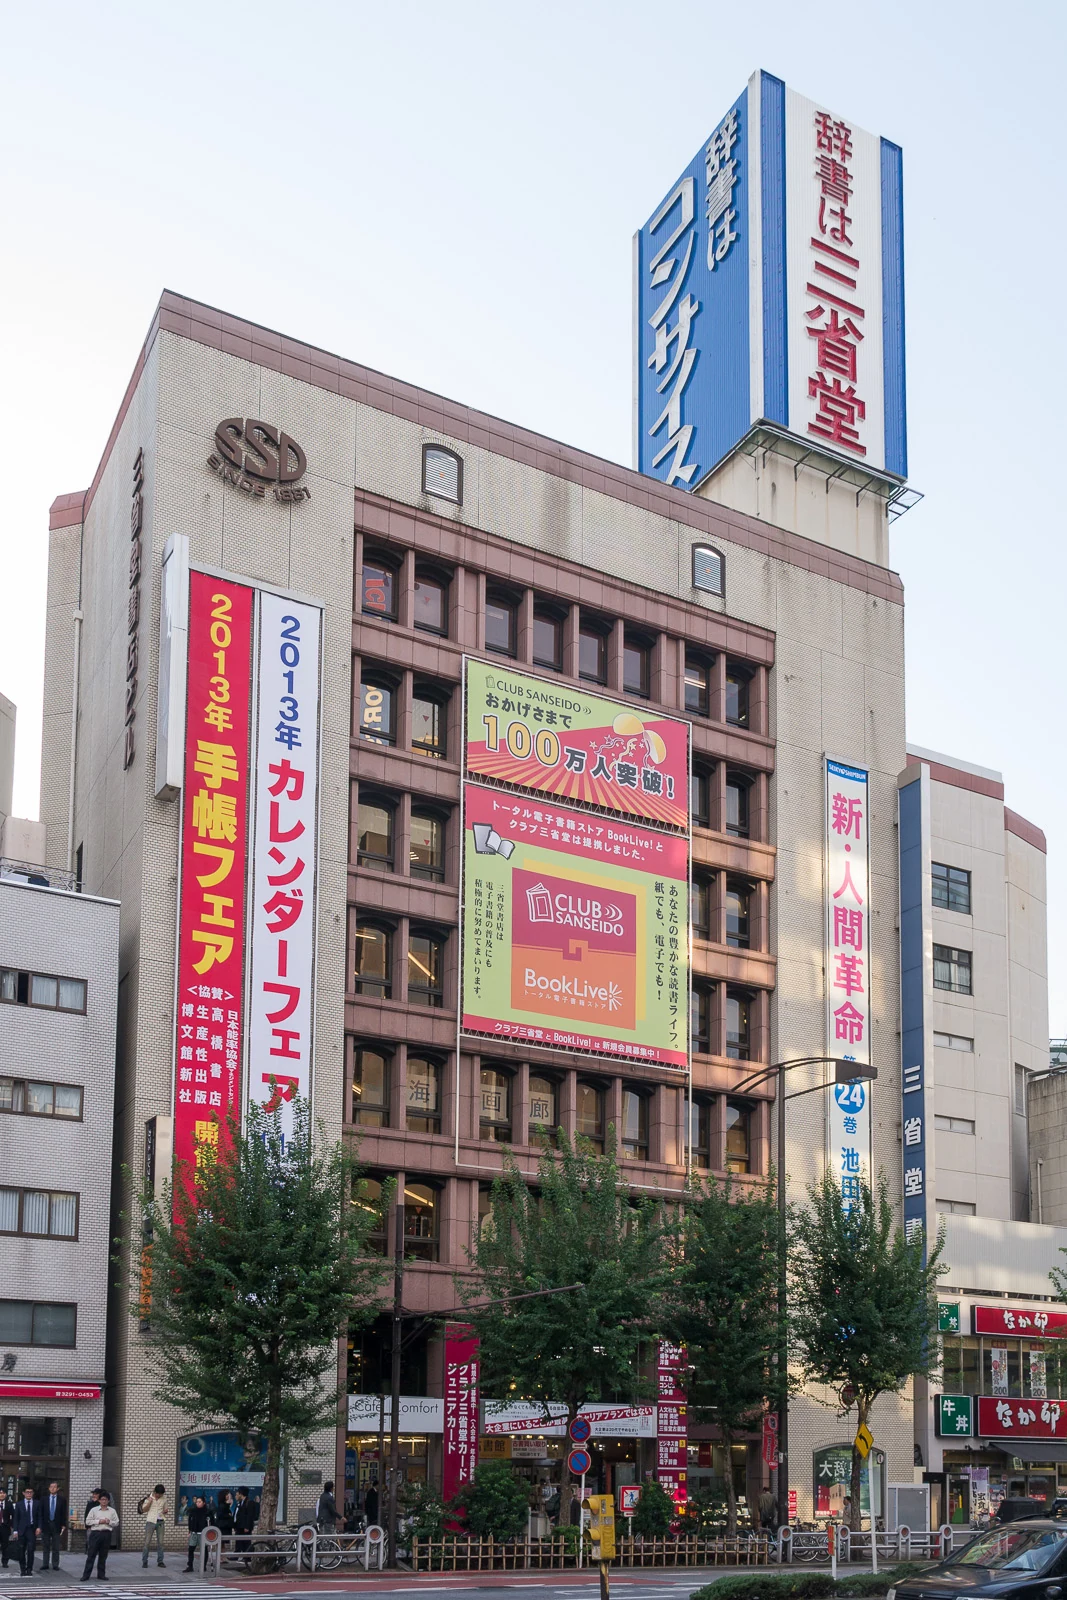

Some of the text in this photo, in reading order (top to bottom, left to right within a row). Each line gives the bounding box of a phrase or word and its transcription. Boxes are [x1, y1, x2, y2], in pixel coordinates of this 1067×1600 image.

[704, 107, 738, 272] 辞書は
[805, 110, 867, 457] 辞書は三省堂
[647, 176, 701, 485] コンサイス
[206, 453, 312, 503] SINCE 1881
[213, 417, 307, 483] SSD
[275, 615, 302, 751] 2013年
[485, 692, 573, 729] おかげさまで
[496, 679, 581, 714] CLUB SANSEIDO
[191, 593, 239, 975] 2013年 手帳フェア
[509, 819, 646, 861] クラブ三省堂は提携しました。
[607, 829, 653, 850] BookLive!
[261, 758, 306, 1114] カレンダーフェア
[496, 884, 505, 941] 三省堂書店は
[554, 893, 602, 919] CLUB
[555, 911, 624, 937] SANSEIDO
[668, 884, 679, 1049] あなたの豊かな読書ライフ。
[178, 1002, 194, 1104] 博文館新社
[194, 1004, 209, 1106] 生産性出版
[209, 1007, 224, 1107] 高橋書店
[494, 1022, 544, 1039] クラブ三省堂
[553, 1032, 592, 1049] BookLive!
[942, 1400, 969, 1432] 牛丼
[995, 1400, 1061, 1435] なか卯
